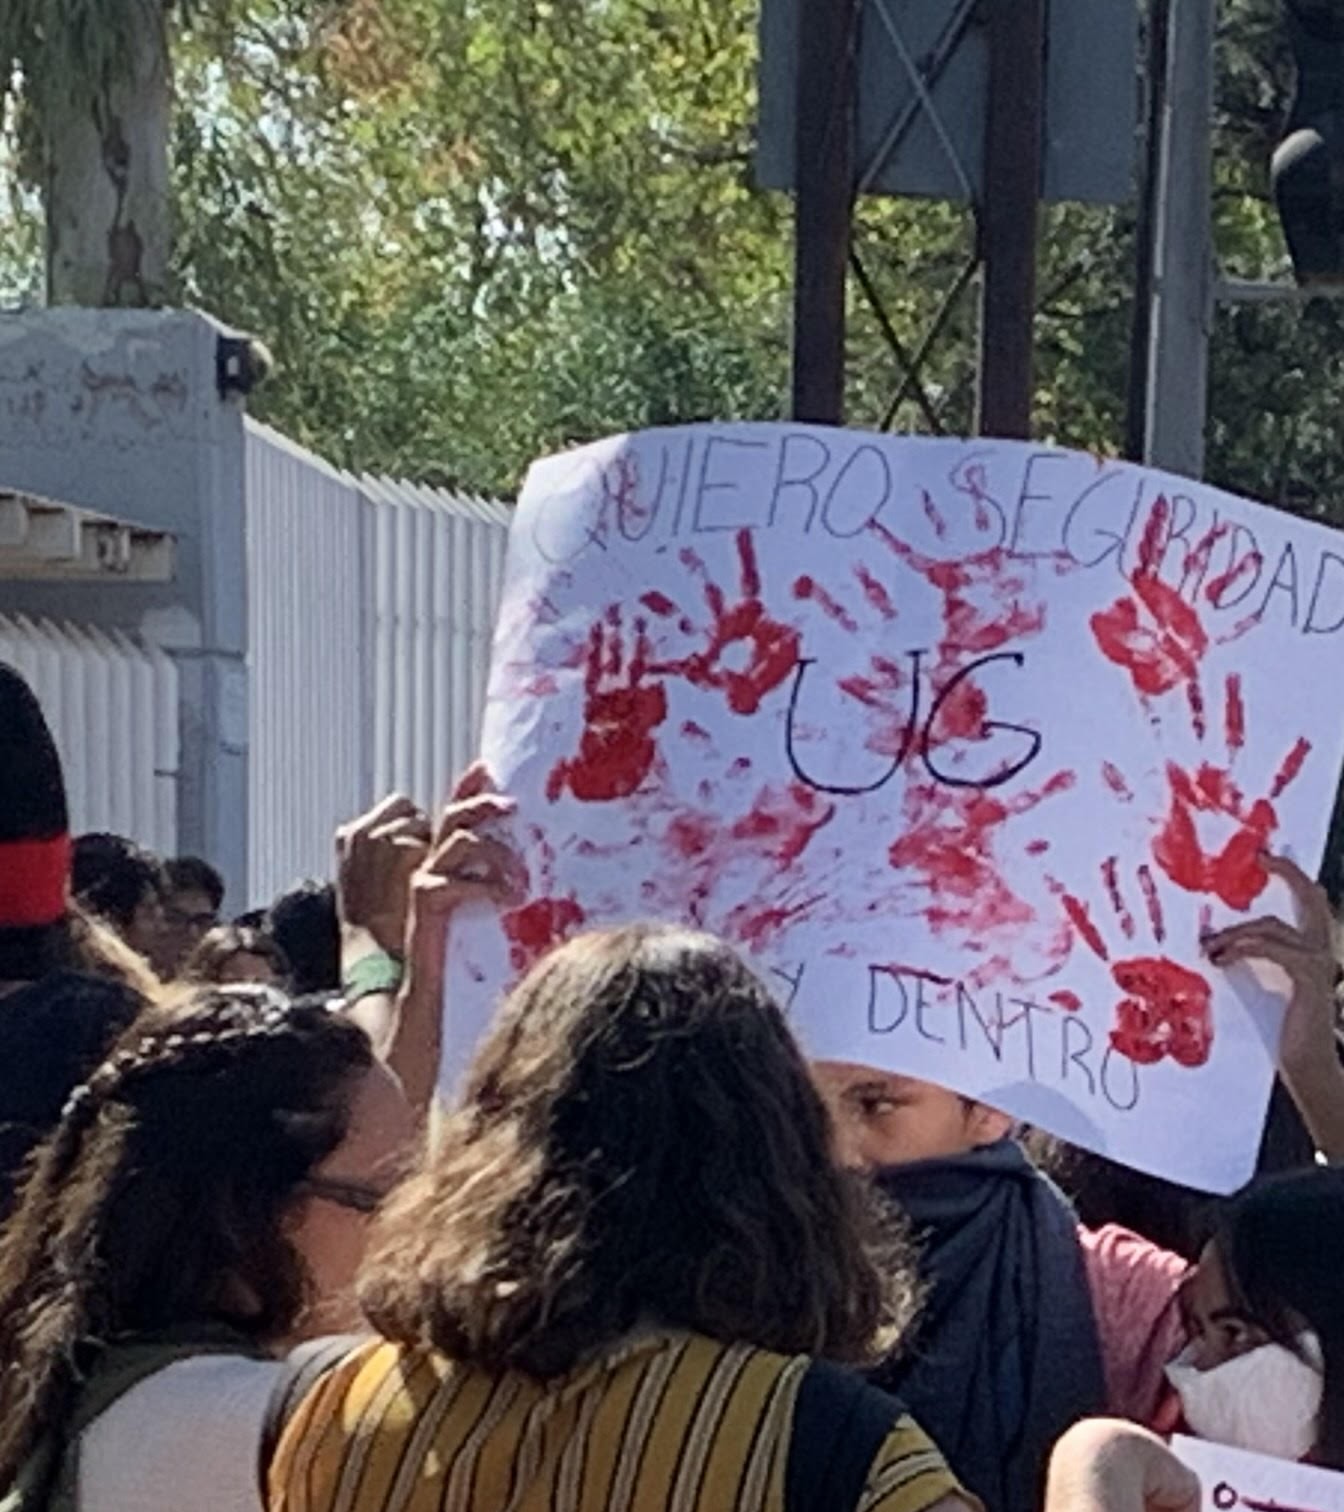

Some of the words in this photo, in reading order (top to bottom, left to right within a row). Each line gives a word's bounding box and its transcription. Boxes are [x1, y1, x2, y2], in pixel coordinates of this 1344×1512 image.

[533, 433, 893, 564] QUIERO
[785, 649, 1042, 796] UG
[868, 962, 1140, 1111] DENTRO
